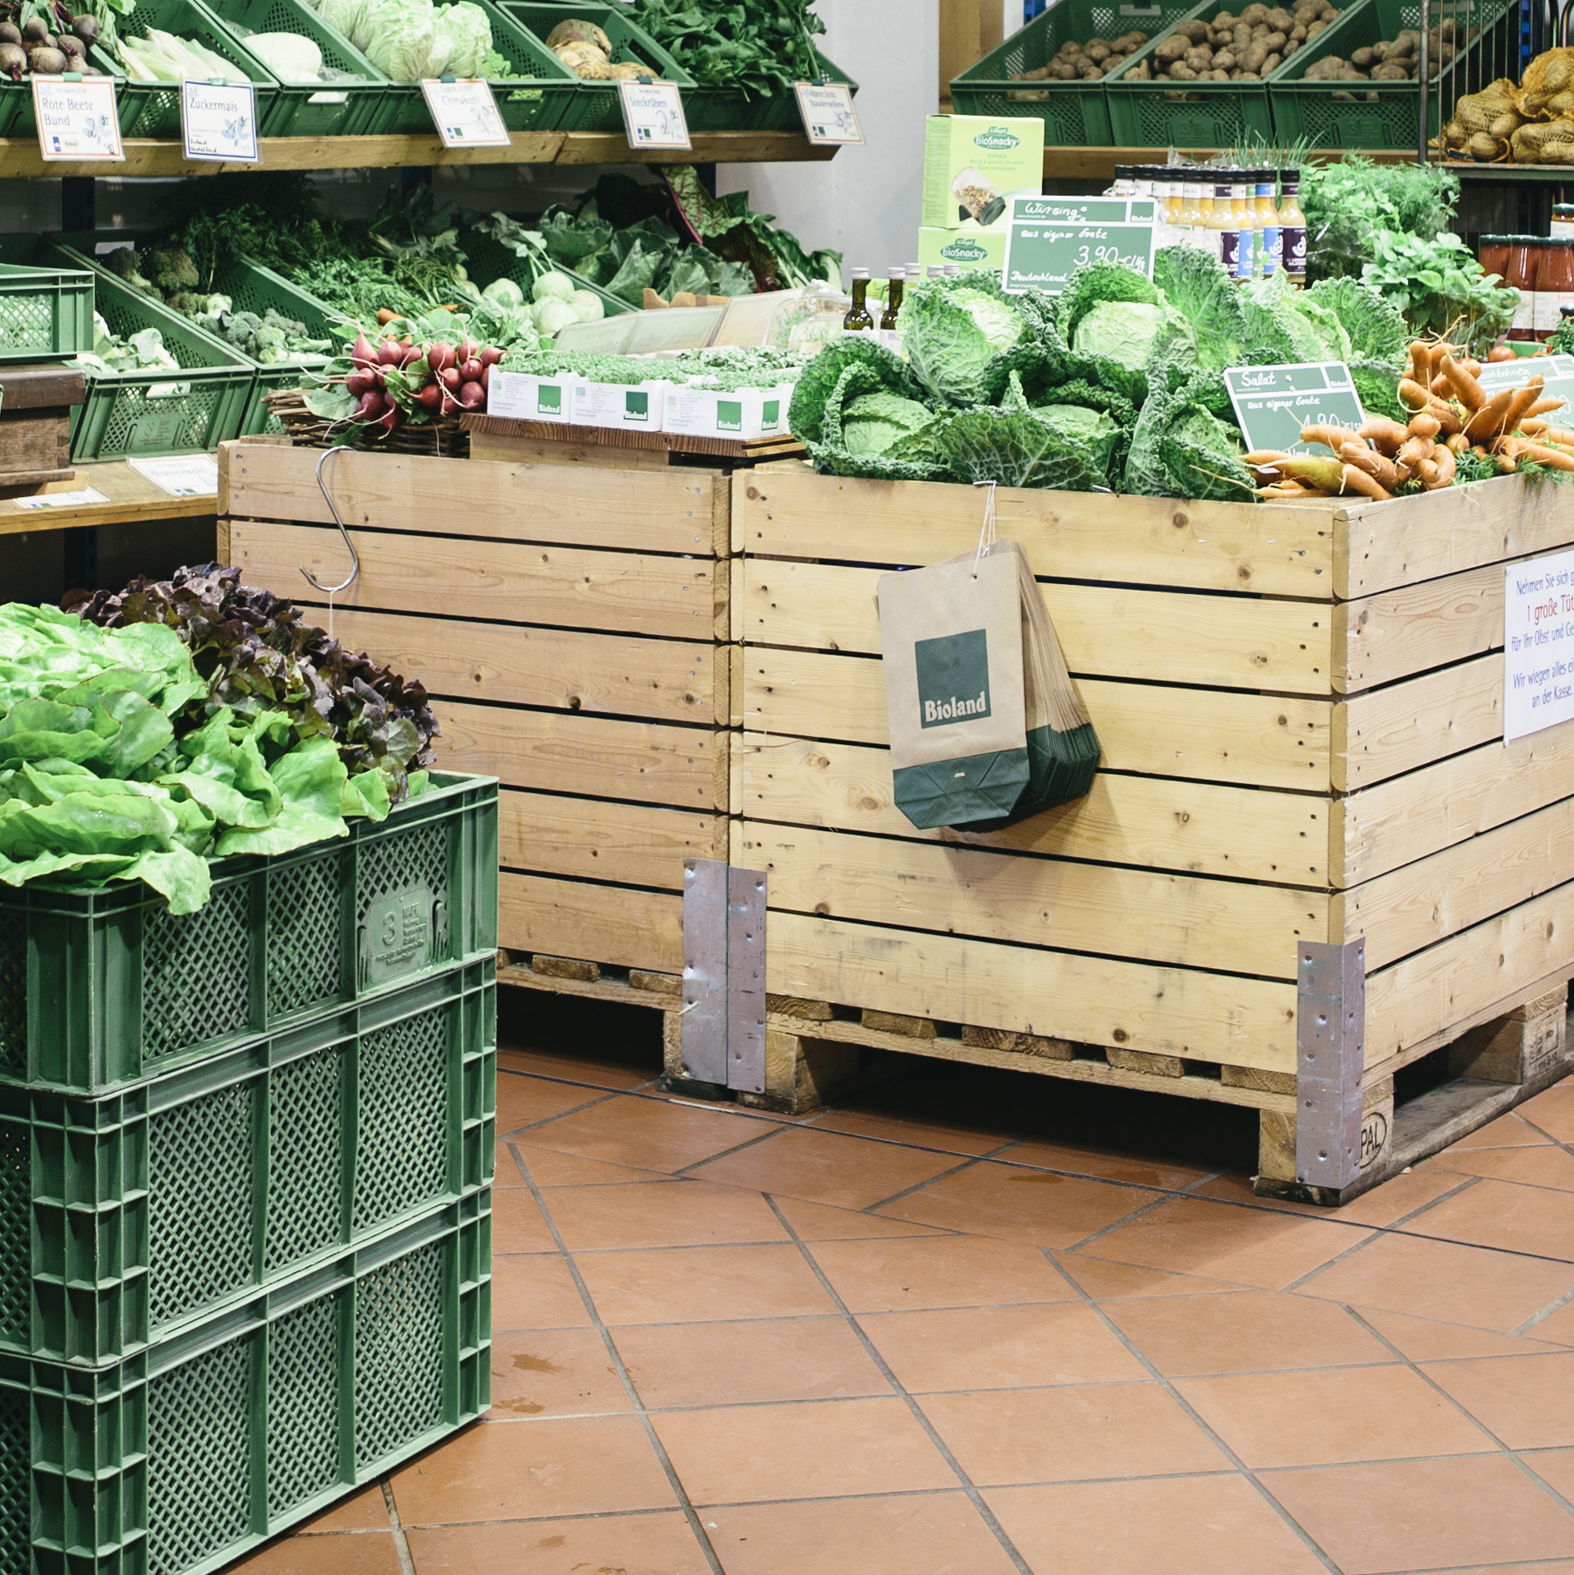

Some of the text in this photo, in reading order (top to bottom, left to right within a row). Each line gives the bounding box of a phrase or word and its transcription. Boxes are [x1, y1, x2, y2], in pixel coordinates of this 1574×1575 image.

[42, 98, 94, 111] Rote Beete
[189, 97, 238, 113] Zuckermais
[44, 113, 70, 127] Bund
[975, 133, 1020, 149] bioSnacky
[1024, 202, 1081, 223] Wirsing
[1021, 229, 1039, 241] aus
[1043, 229, 1075, 243] eigener
[942, 246, 987, 261] bioSnacky
[1241, 371, 1277, 388] Salat
[1247, 400, 1264, 410] aus
[1516, 577, 1544, 596] Nehmen
[1545, 572, 1556, 589] Sie
[1556, 569, 1569, 587] sich
[1534, 597, 1558, 626] große
[1511, 633, 1522, 652] für
[1522, 629, 1534, 648] Ihr
[1534, 626, 1551, 646] Obst
[1551, 622, 1565, 641] und
[1513, 672, 1526, 690] Wir
[1527, 668, 1552, 687] wiegen
[1552, 660, 1567, 678] alles
[1531, 684, 1574, 709] an der Kasse.
[924, 691, 987, 723] Bioland
